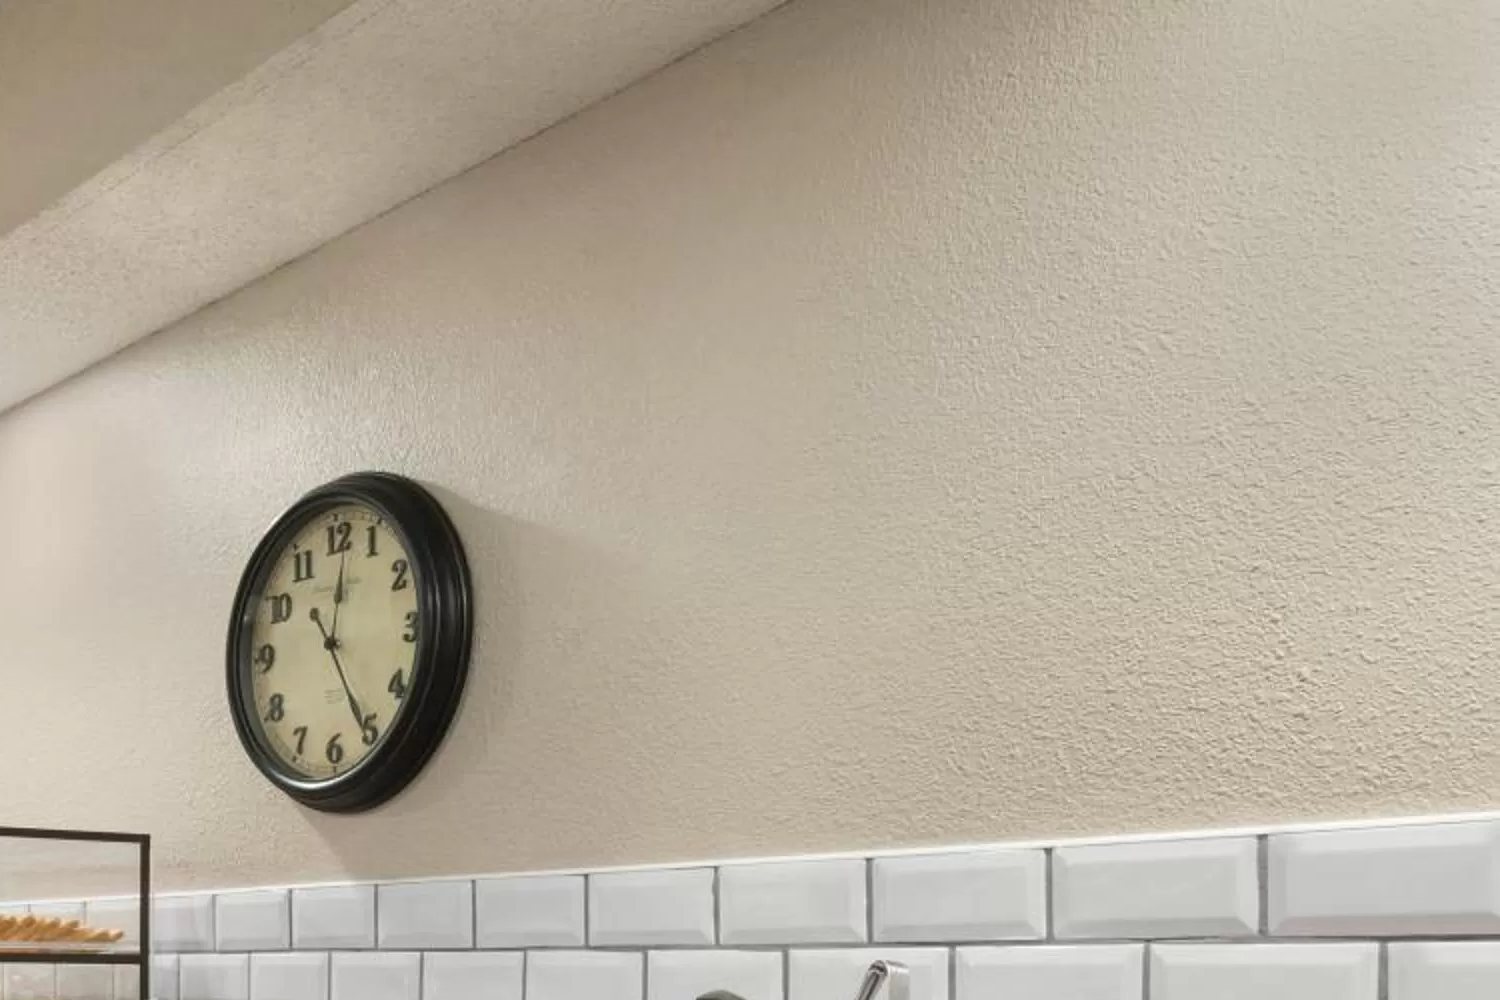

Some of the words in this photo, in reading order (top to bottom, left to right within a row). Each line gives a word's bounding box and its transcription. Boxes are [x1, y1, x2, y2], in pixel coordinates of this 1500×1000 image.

[326, 522, 352, 556] 12
[366, 525, 379, 558] 1
[292, 550, 315, 582] 11
[391, 559, 408, 591] 2
[266, 593, 293, 624] 10
[402, 612, 419, 643] 3
[254, 643, 275, 674] 9
[388, 668, 407, 700] 4
[264, 693, 285, 723] 8
[293, 726, 308, 755] 7
[362, 713, 379, 746] 5
[325, 733, 343, 764] 6
